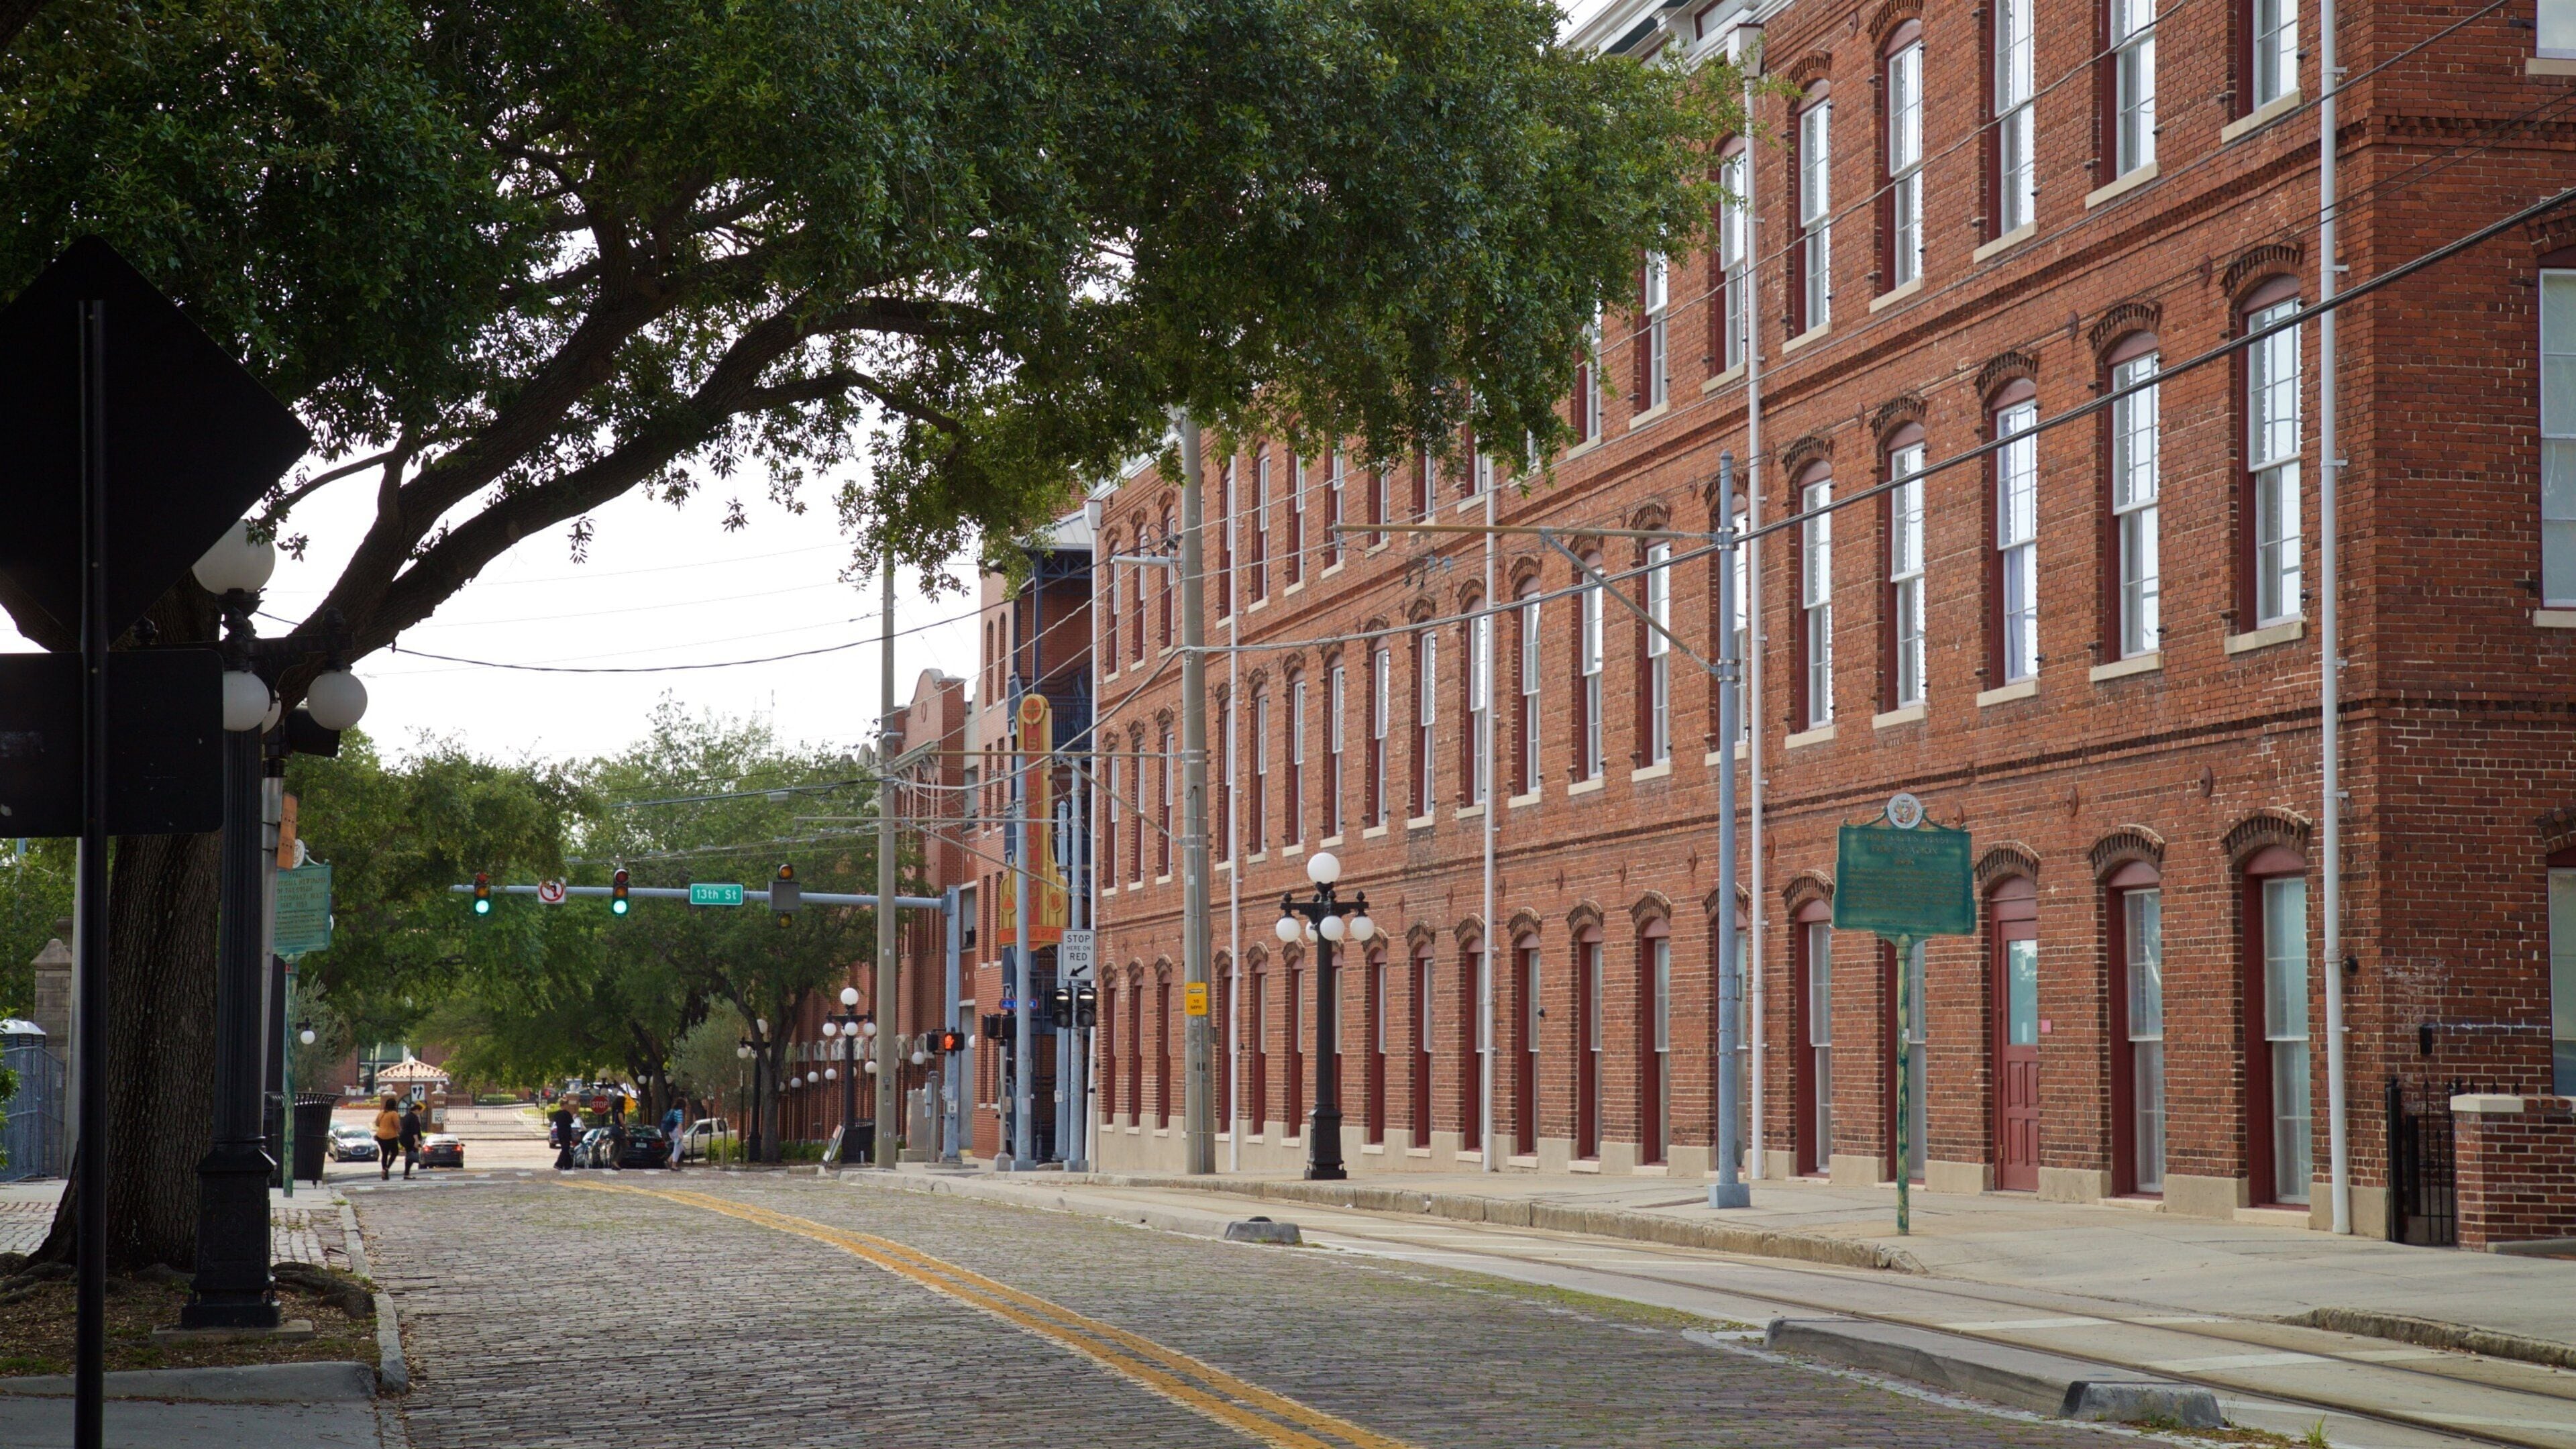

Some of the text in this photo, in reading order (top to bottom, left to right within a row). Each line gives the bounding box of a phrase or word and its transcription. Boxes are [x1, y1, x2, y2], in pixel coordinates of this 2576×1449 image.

[696, 889, 737, 900] 13th St
[1008, 929, 1058, 939] TMPA
[1067, 934, 1090, 943] STOP
[1069, 953, 1087, 961] RED
